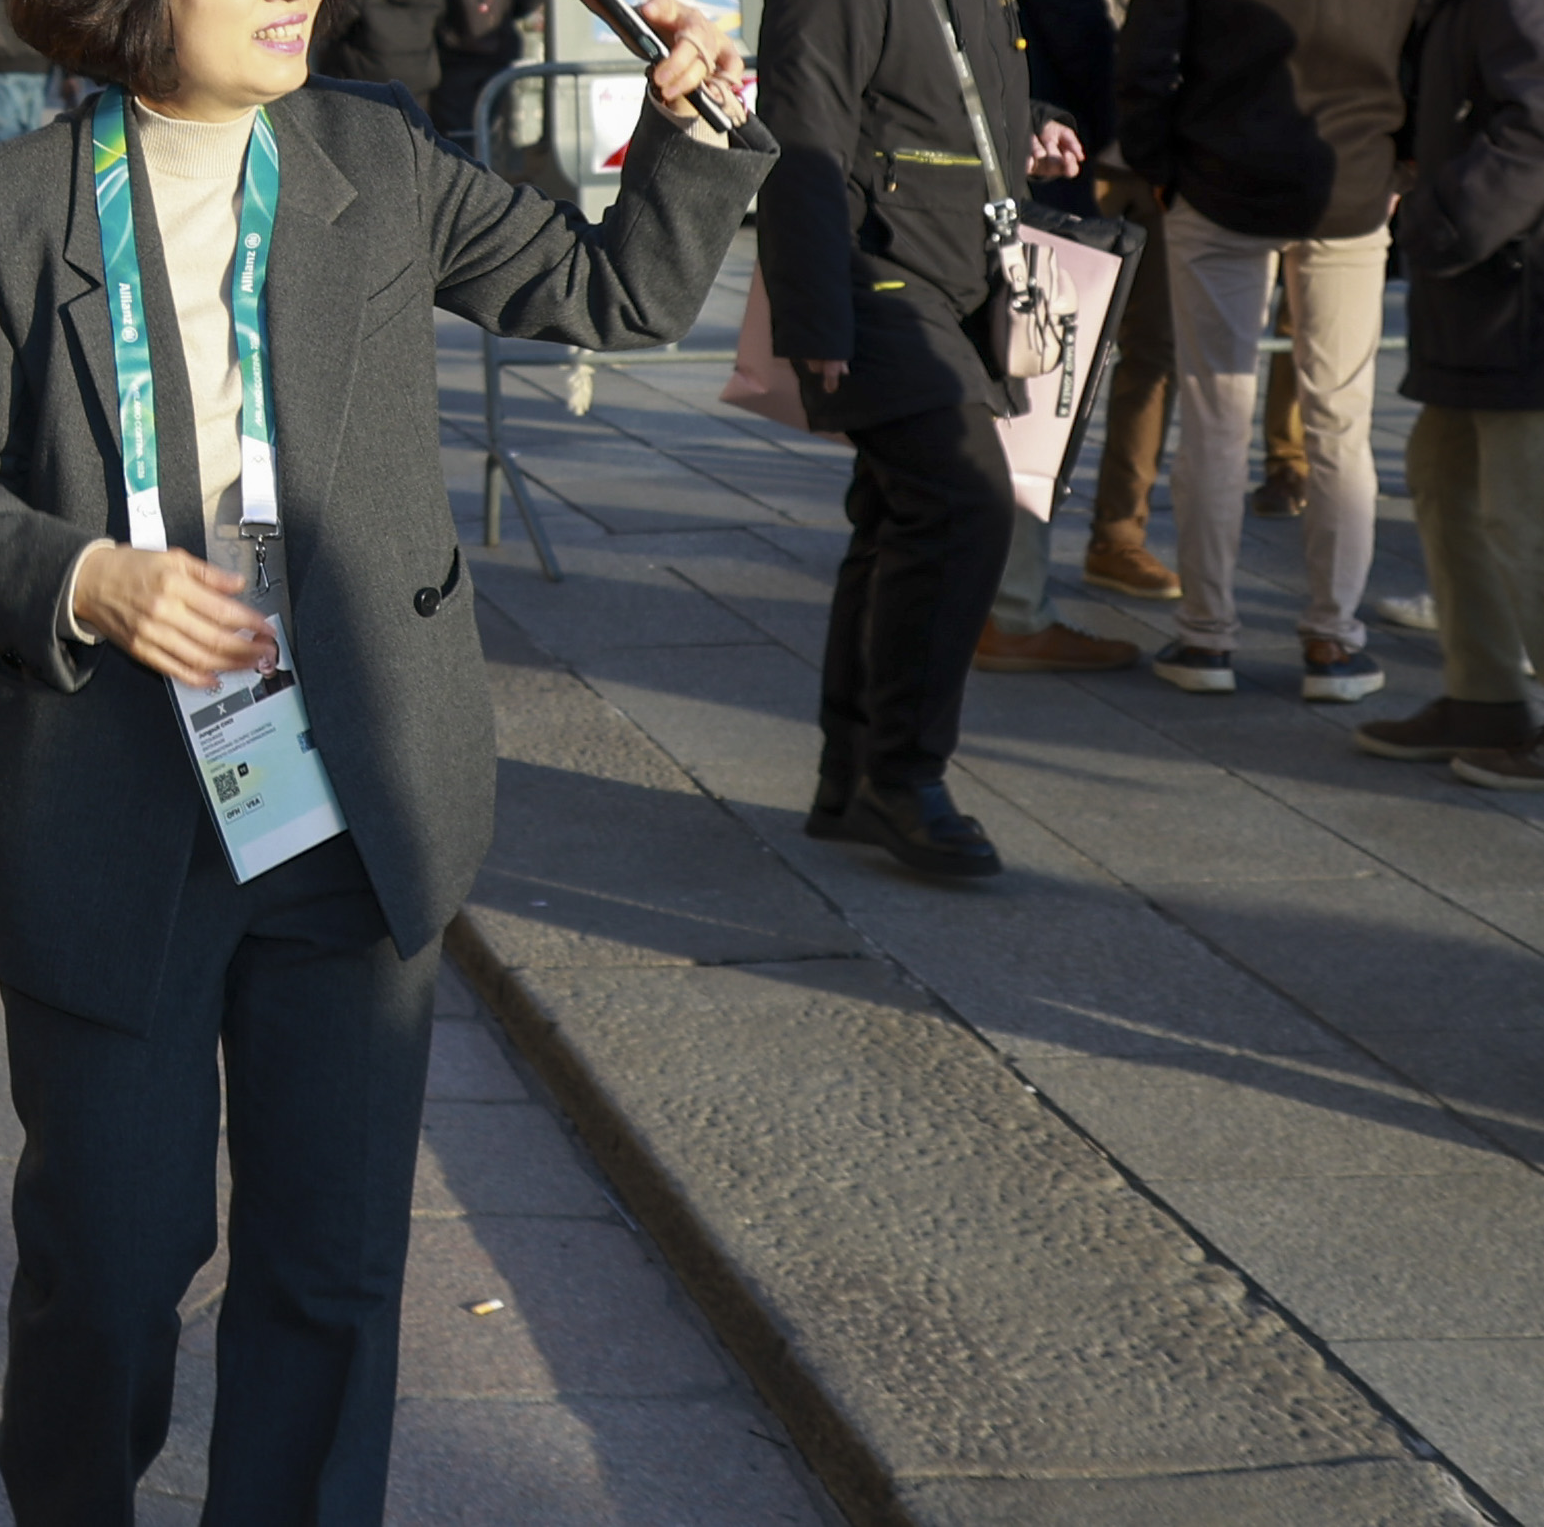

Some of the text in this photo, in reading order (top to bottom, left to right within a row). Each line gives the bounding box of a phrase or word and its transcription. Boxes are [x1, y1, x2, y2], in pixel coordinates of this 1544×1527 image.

[241, 250, 256, 293] Allianz
[118, 282, 133, 325] Allianz
[217, 703, 228, 716] X
